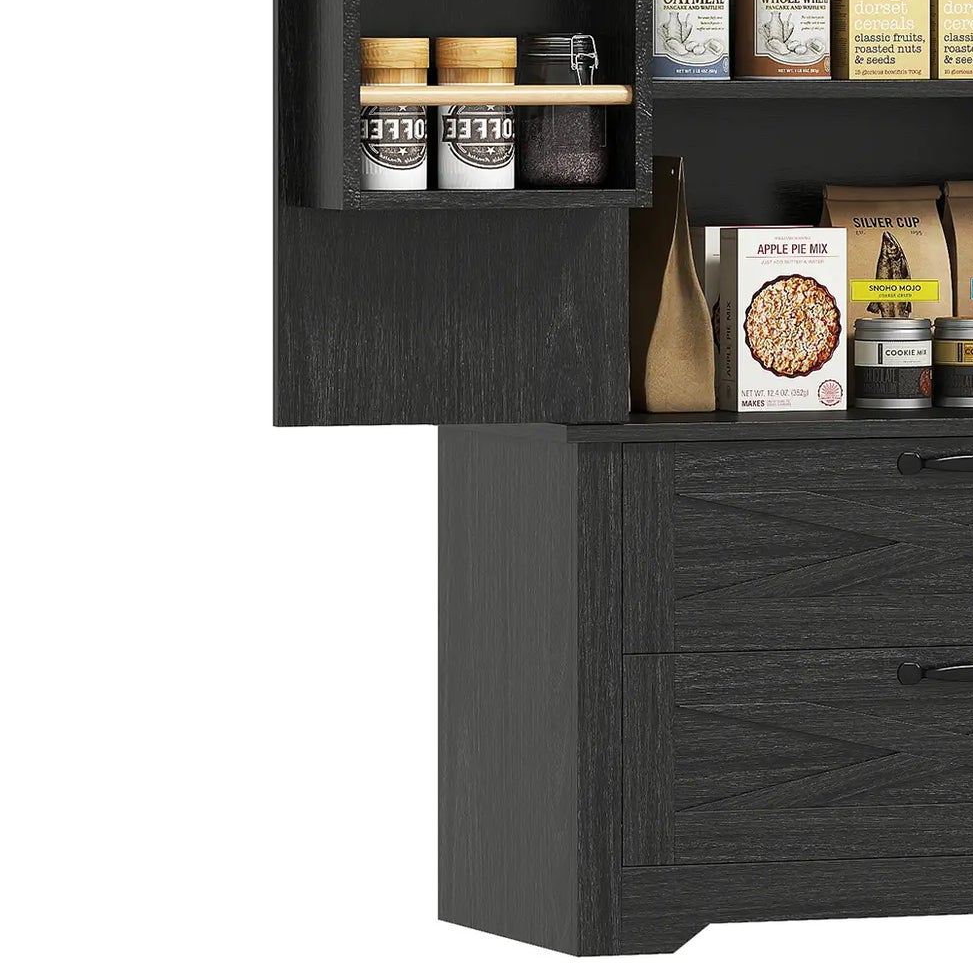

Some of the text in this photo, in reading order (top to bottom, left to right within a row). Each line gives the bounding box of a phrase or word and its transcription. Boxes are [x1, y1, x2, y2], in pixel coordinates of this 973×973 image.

[854, 1, 909, 15] dorset
[854, 17, 915, 30] cereals
[854, 33, 926, 43] classic fruits,
[855, 44, 922, 54] roasted nuts
[854, 55, 896, 64] & seeds
[943, 55, 953, 64] &
[853, 217, 920, 228] SILVER CUP
[757, 243, 828, 255] APPLE PIE MIX
[869, 284, 922, 292] SNOHO MOJO
[741, 389, 754, 397] NET
